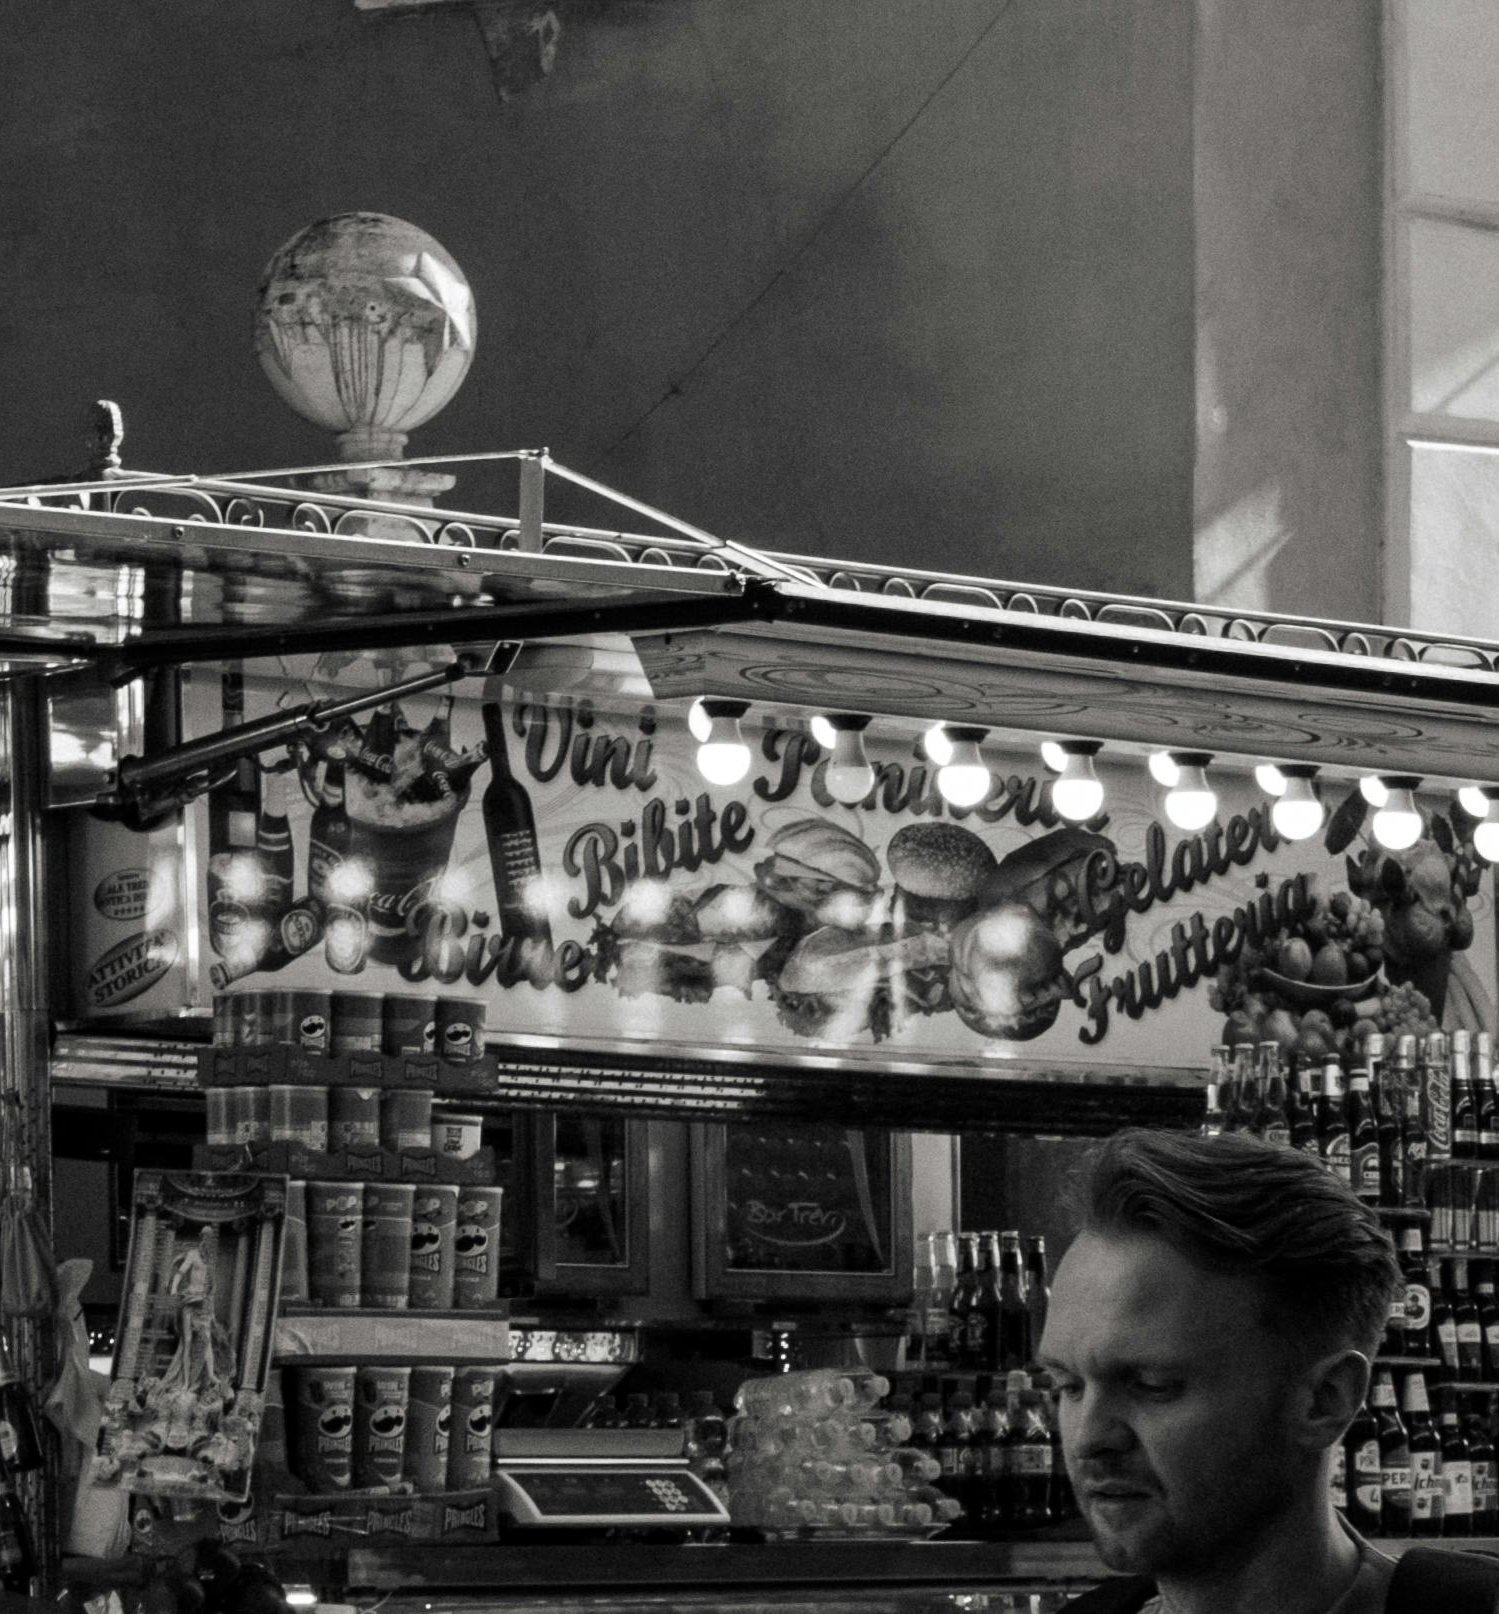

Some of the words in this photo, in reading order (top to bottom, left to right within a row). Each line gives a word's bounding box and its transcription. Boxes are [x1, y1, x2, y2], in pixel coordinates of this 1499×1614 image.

[512, 697, 658, 792] Vini
[563, 792, 755, 920] Bibite
[1078, 800, 1292, 955] Gelater
[398, 903, 592, 993] Birre
[1073, 872, 1317, 1045] Frutteria
